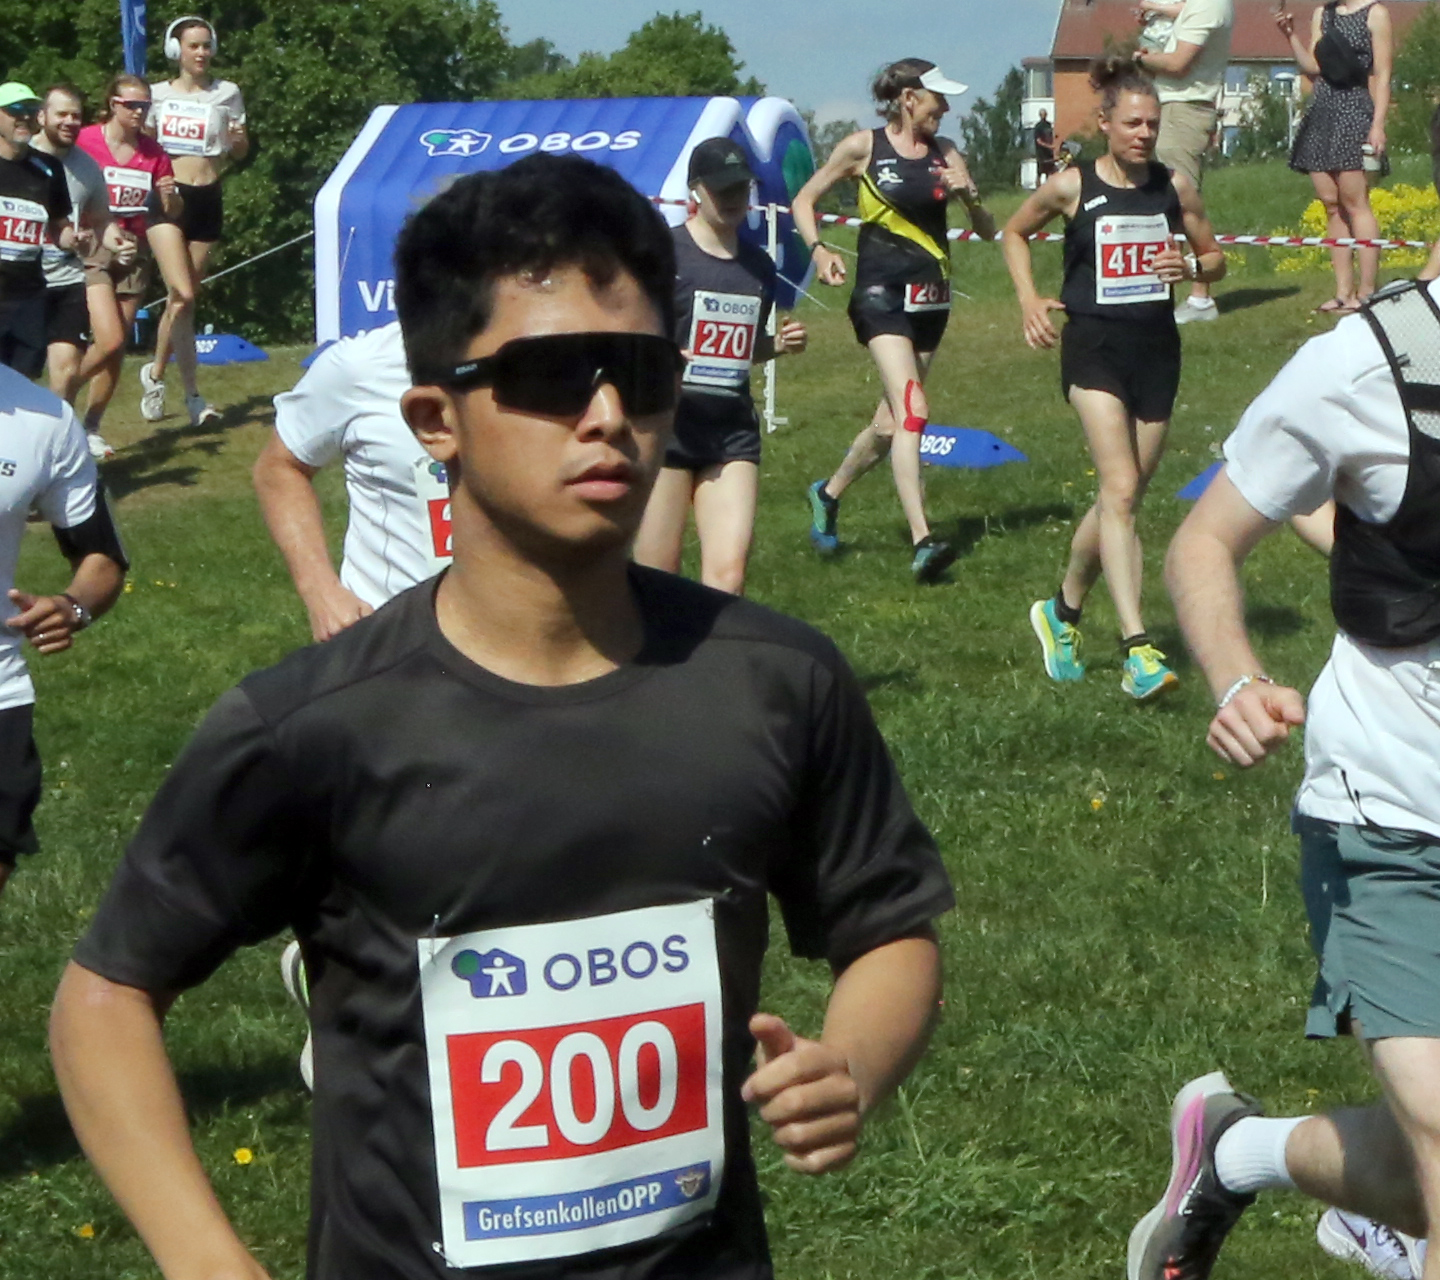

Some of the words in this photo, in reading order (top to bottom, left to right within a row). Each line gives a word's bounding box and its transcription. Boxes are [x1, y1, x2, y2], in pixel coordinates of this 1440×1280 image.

[499, 130, 642, 154] OBOS
[3, 218, 37, 243] 144
[1107, 244, 1159, 275] 415
[722, 303, 755, 315] OBOS
[700, 323, 748, 358] 270
[920, 434, 957, 456] BOS
[543, 934, 690, 991] OBOS
[480, 1020, 679, 1152] 200
[478, 1181, 662, 1232] GrefsenkollenOPP
